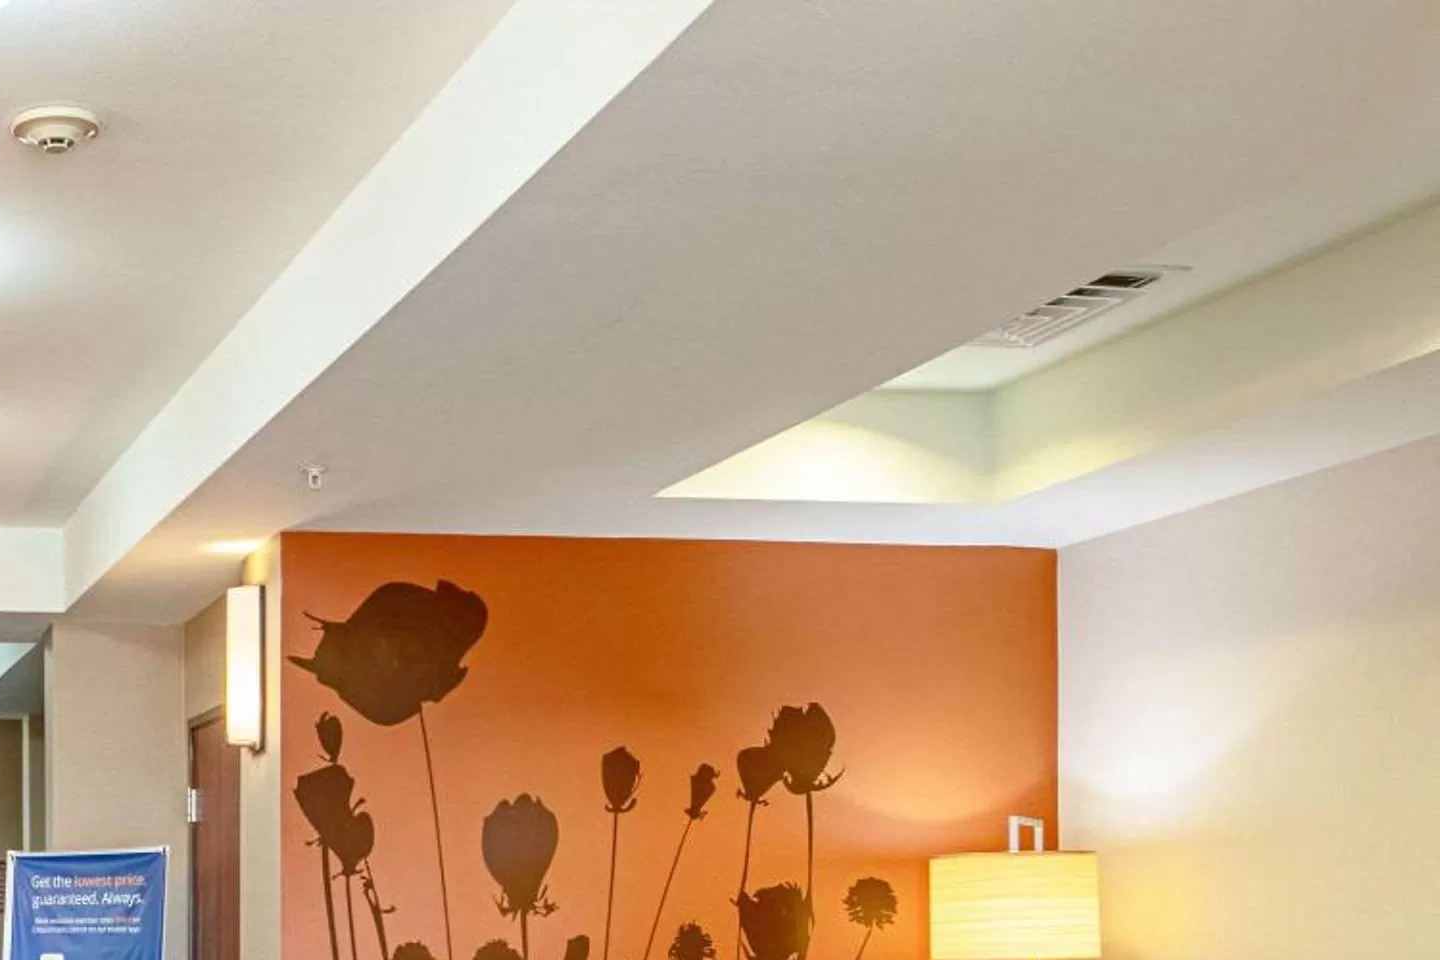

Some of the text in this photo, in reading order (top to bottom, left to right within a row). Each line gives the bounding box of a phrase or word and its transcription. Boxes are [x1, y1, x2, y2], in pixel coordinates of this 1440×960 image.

[31, 875, 50, 888] Get
[53, 875, 72, 888] the
[74, 874, 112, 888] lowest
